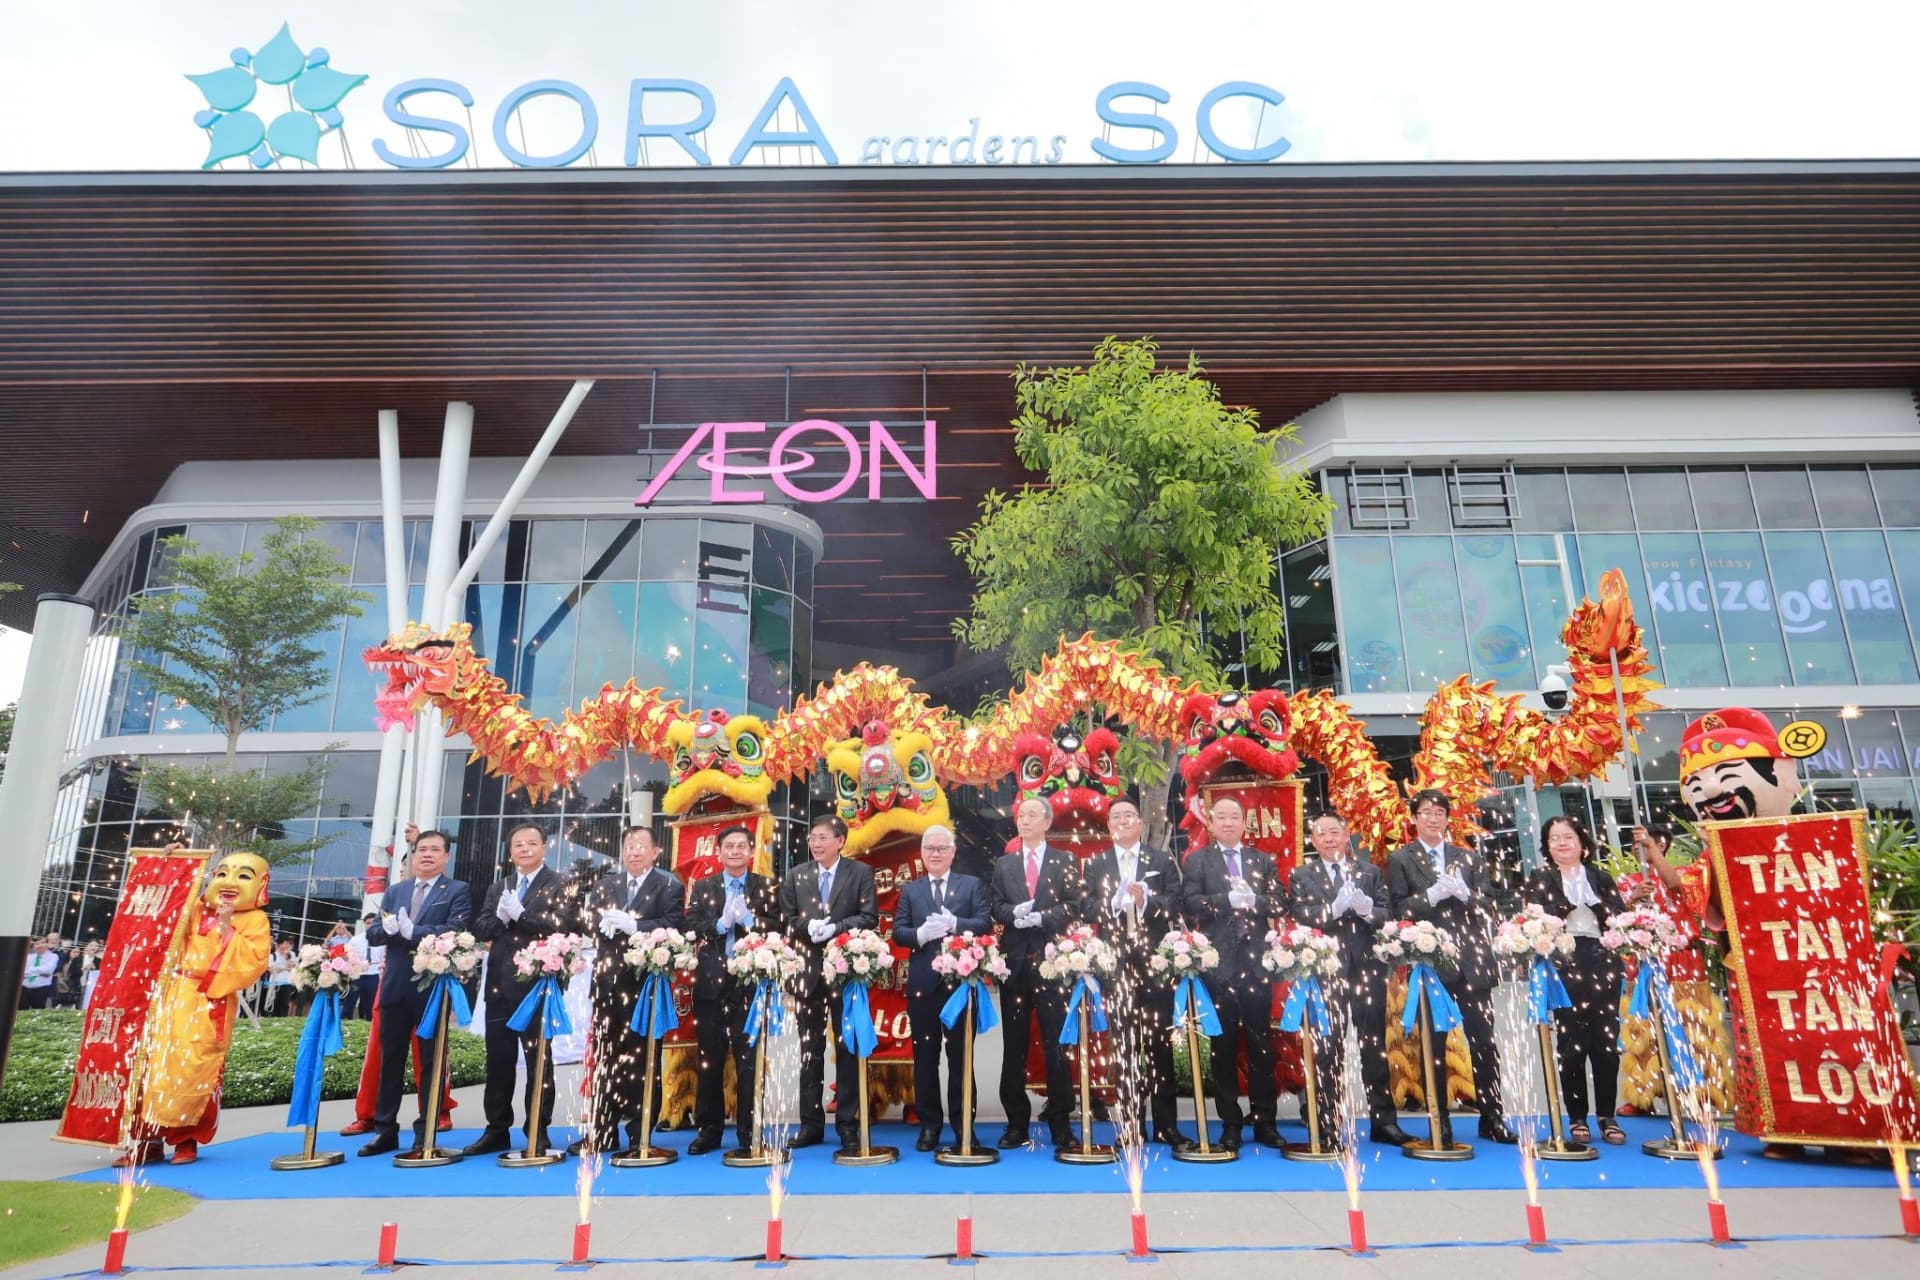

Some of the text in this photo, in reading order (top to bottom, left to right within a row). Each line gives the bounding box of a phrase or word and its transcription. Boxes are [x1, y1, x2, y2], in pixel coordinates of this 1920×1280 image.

[372, 77, 1292, 168] SORA gardens SC
[1688, 558, 1753, 571] Fntasy
[1739, 832, 1841, 894] TẤN
[1760, 905, 1848, 962] TÀI
[1766, 967, 1875, 1032] TẤN
[1784, 1049, 1896, 1115] LỘC
